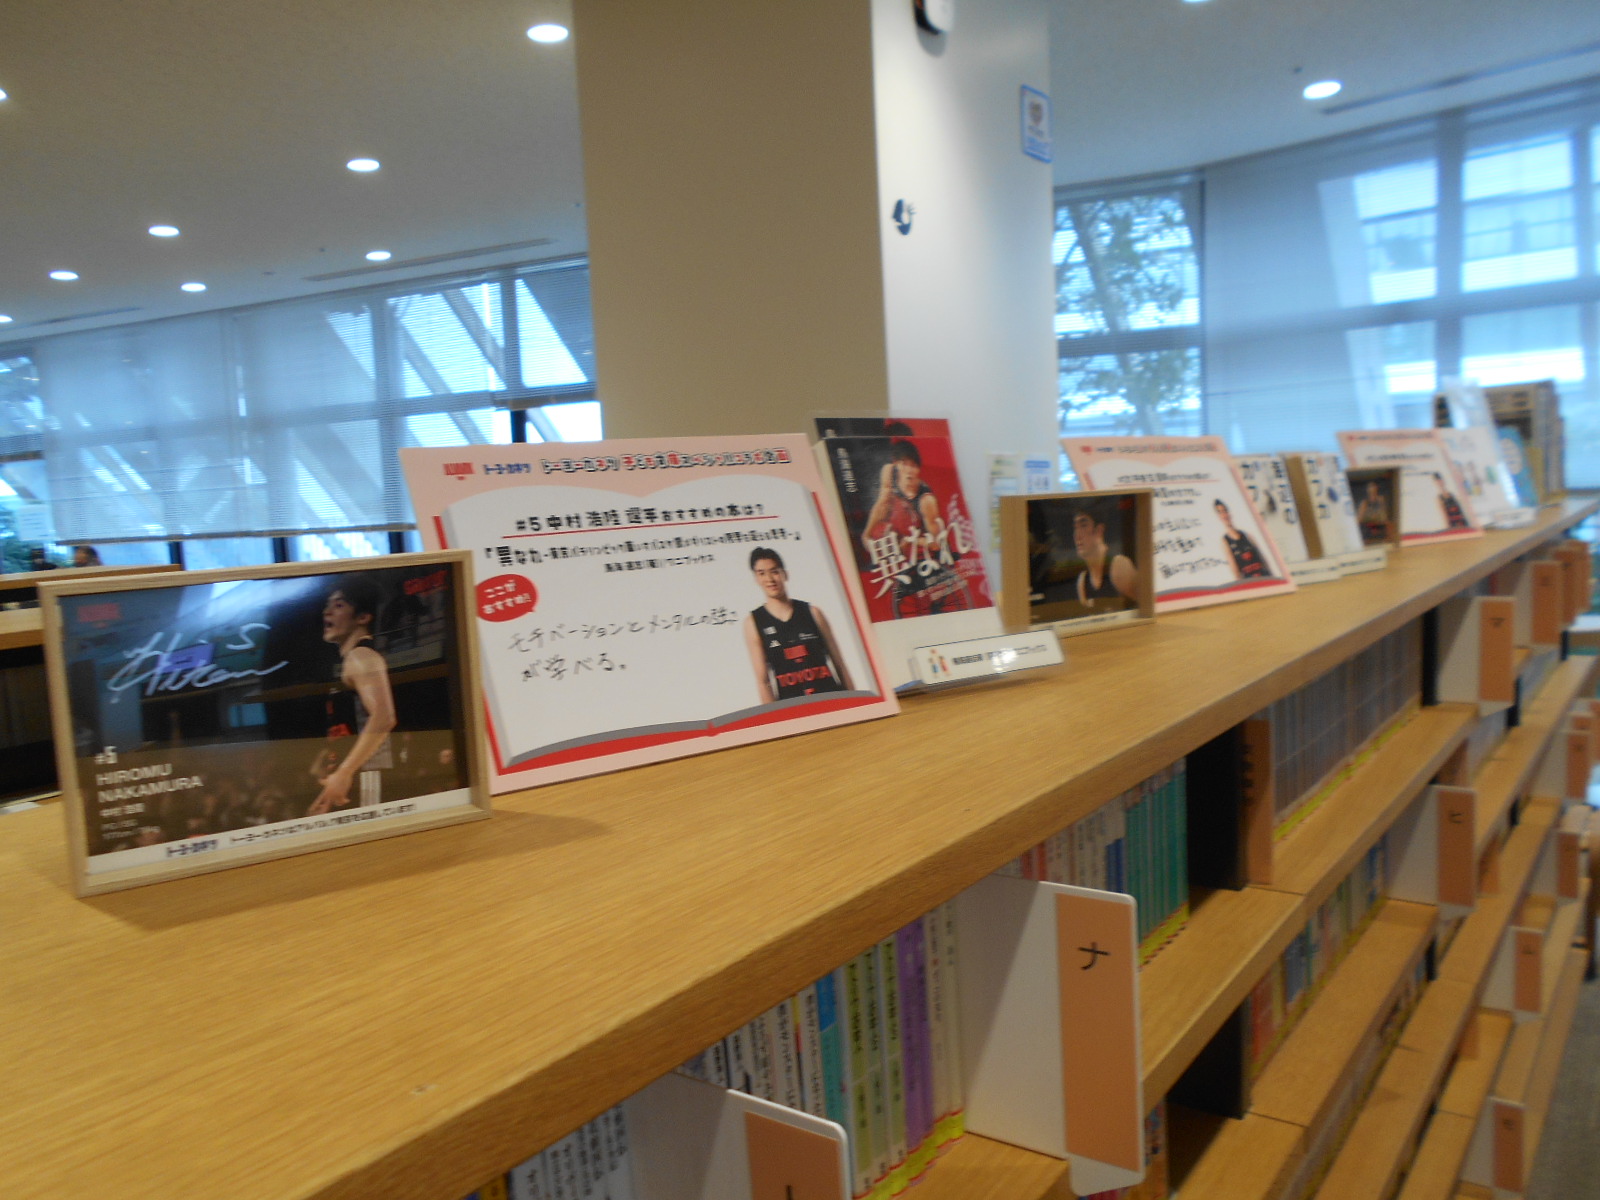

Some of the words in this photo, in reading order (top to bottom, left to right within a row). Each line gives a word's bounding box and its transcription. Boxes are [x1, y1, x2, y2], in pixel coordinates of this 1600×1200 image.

[870, 517, 973, 599] 異なれ
[483, 579, 517, 599] ここが
[776, 665, 833, 688] TOYOTA
[96, 763, 173, 786] HIROMU
[98, 775, 204, 803] NAKAMURA
[1077, 942, 1111, 970] ナ
